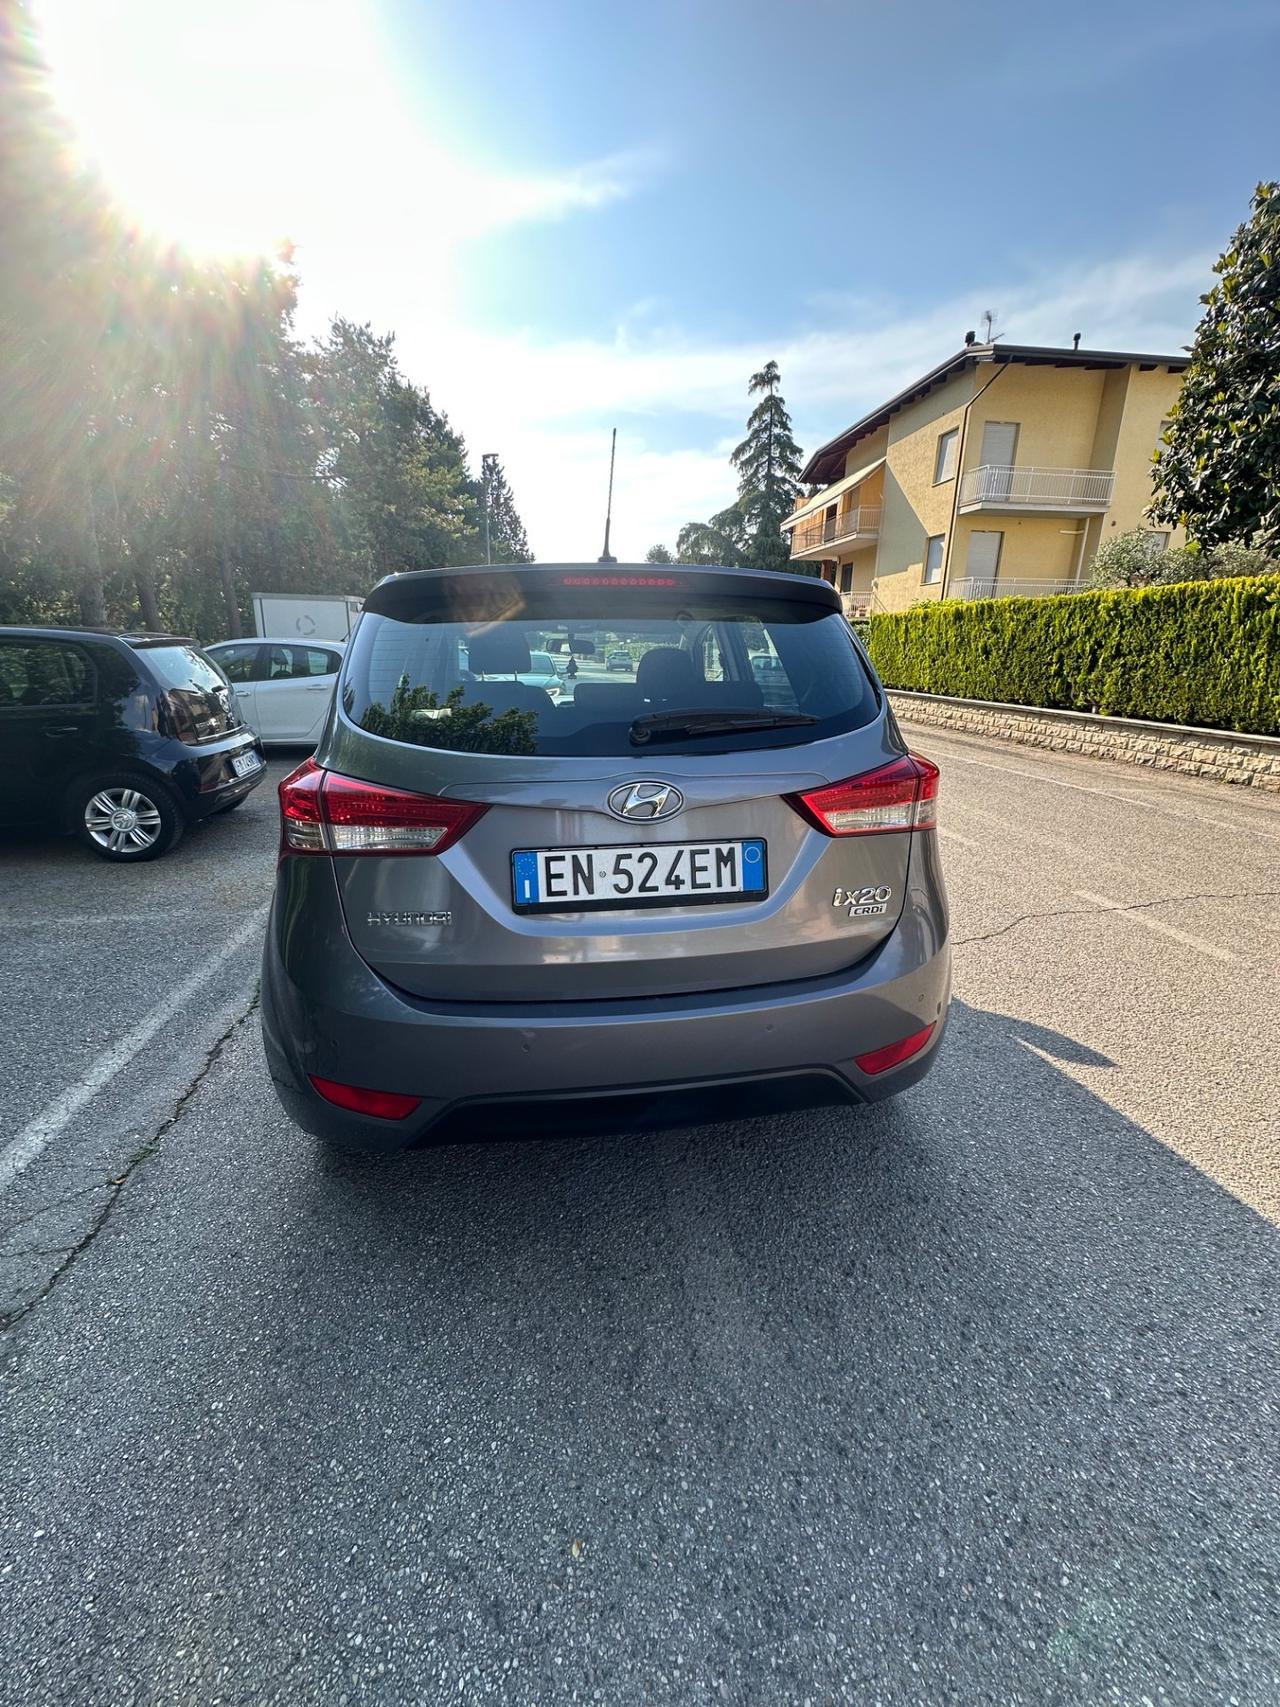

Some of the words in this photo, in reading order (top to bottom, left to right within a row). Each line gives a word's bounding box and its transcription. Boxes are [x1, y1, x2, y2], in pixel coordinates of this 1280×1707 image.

[544, 854, 595, 897] EN
[612, 846, 737, 895] 524EM
[523, 879, 531, 898] I
[831, 885, 892, 907] ix20
[367, 911, 452, 926] HYUNDAI
